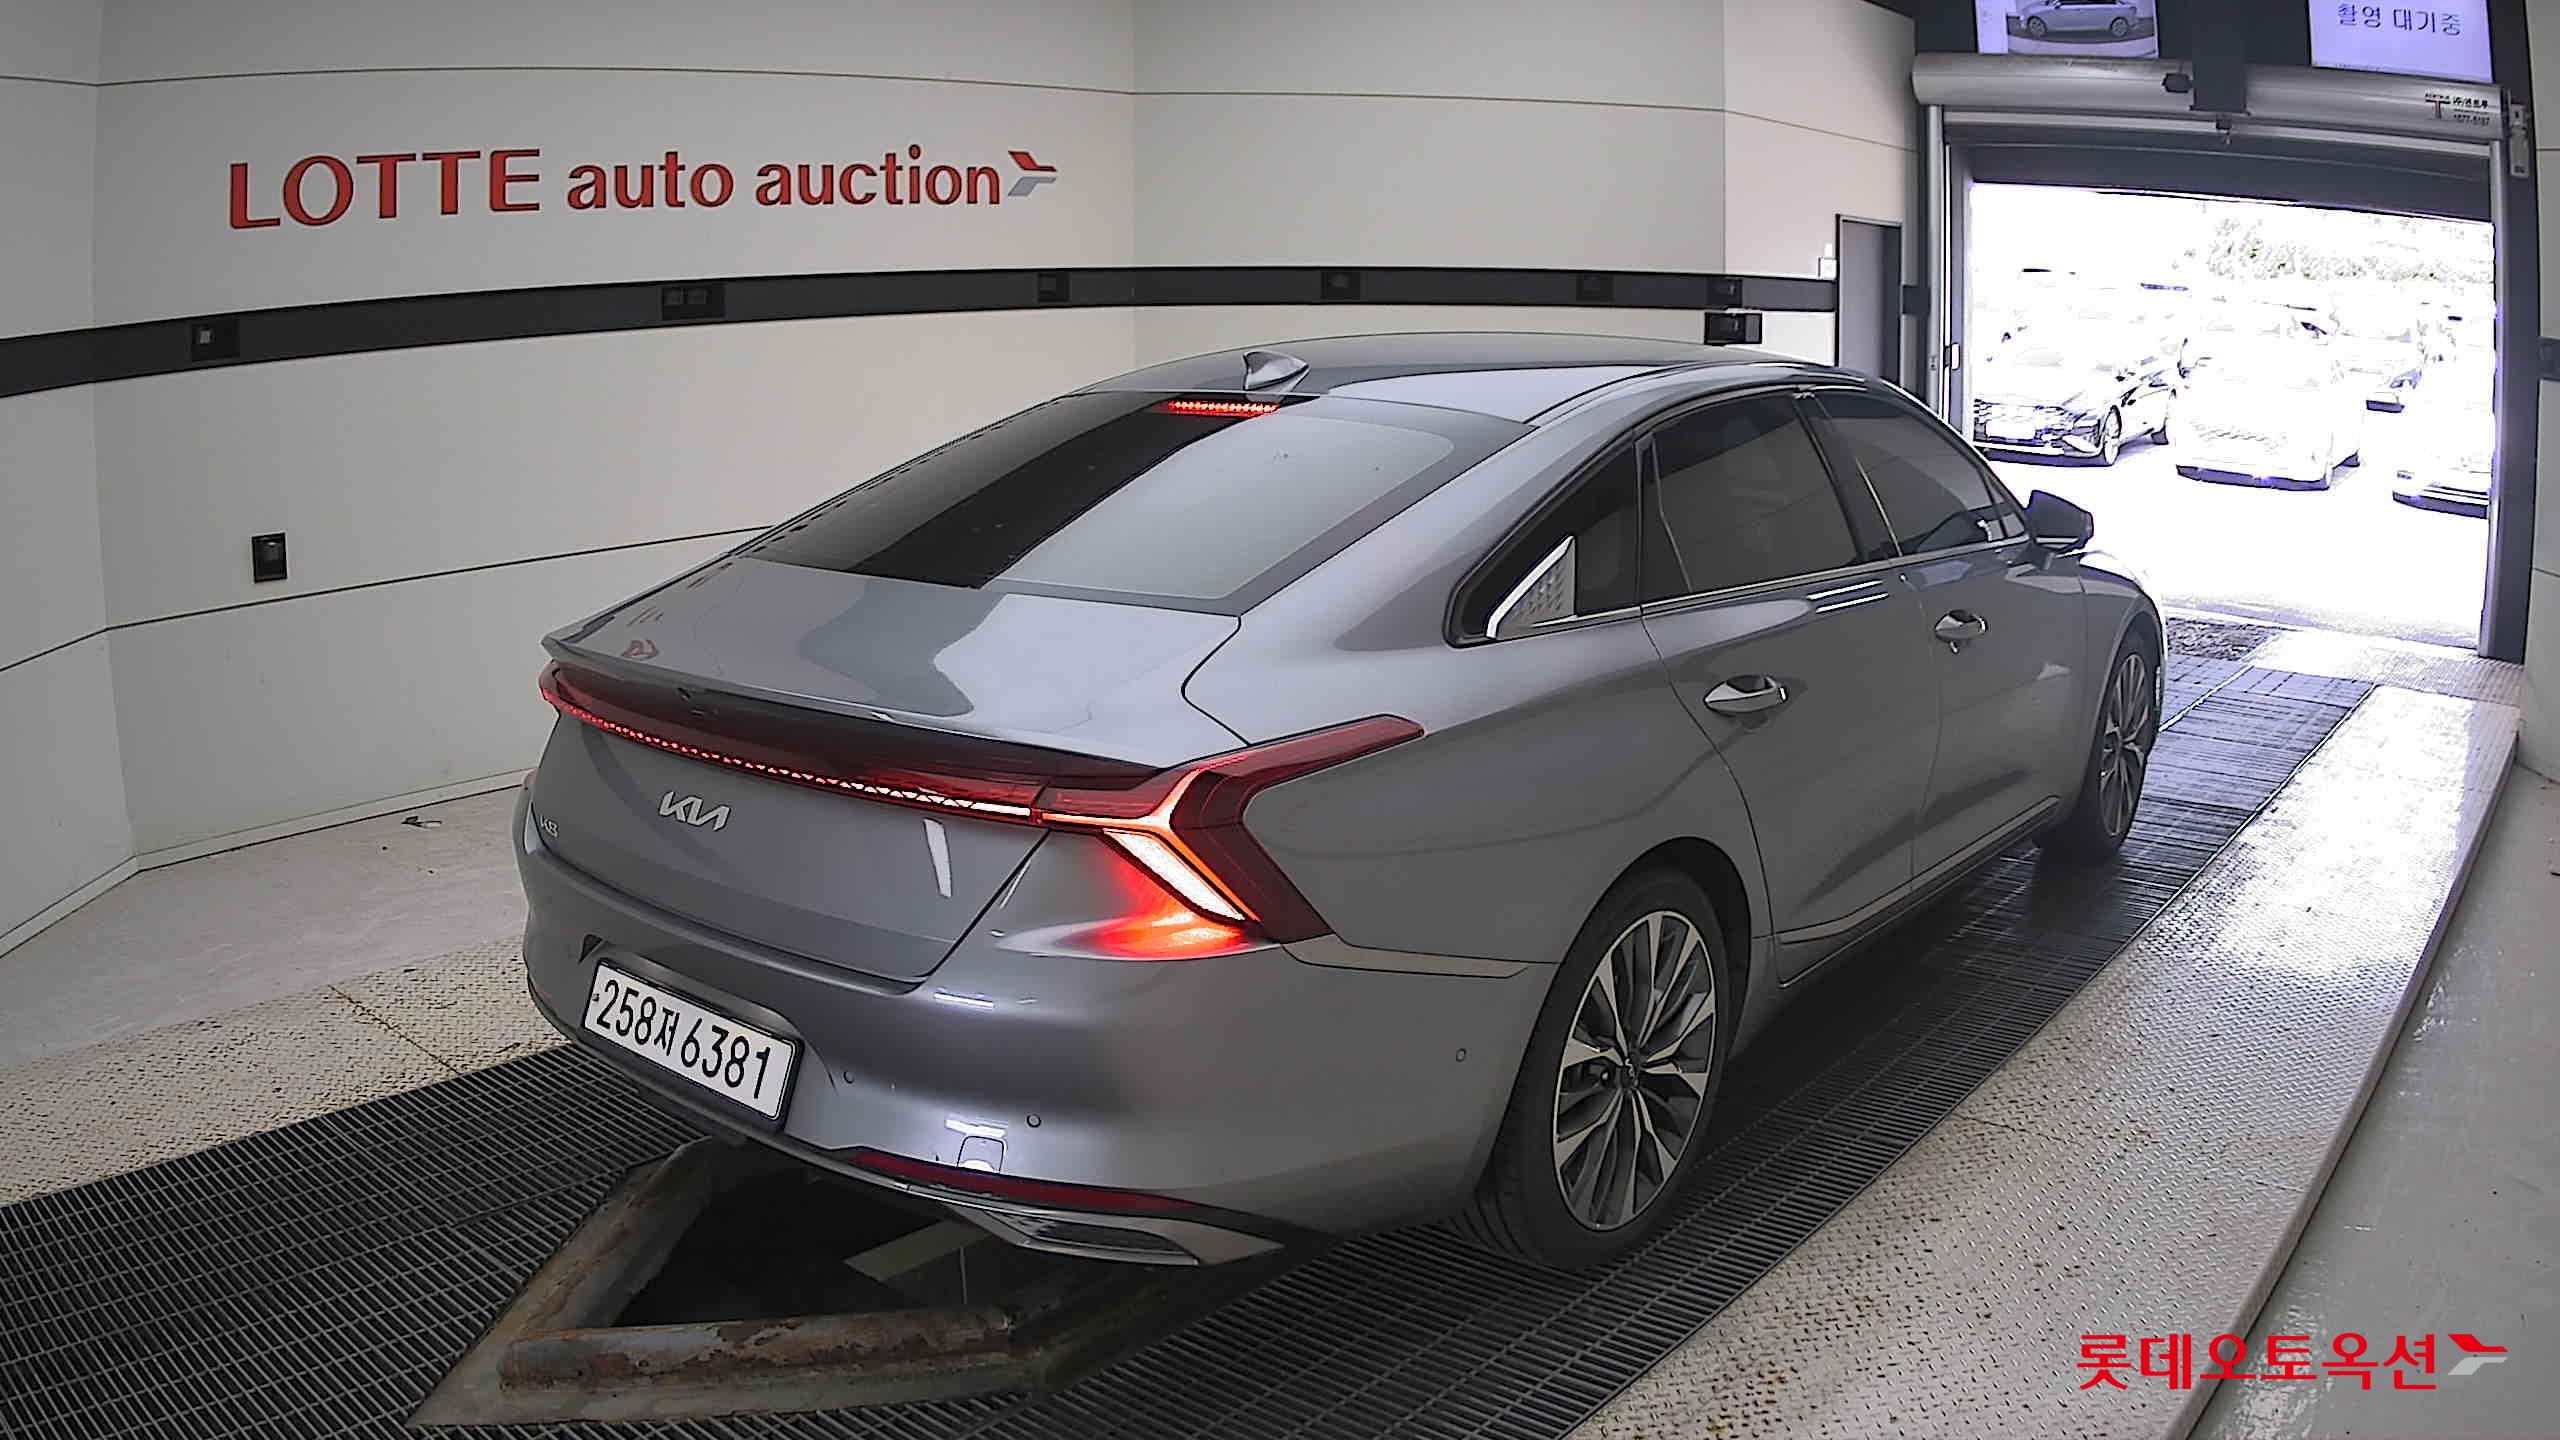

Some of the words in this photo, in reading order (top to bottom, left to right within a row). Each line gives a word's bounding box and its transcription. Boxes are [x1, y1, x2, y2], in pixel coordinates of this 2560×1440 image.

[2338, 2, 2382, 29] 촬영
[229, 148, 541, 230] LOTTE
[566, 149, 736, 210] auto
[753, 143, 1003, 207] auction
